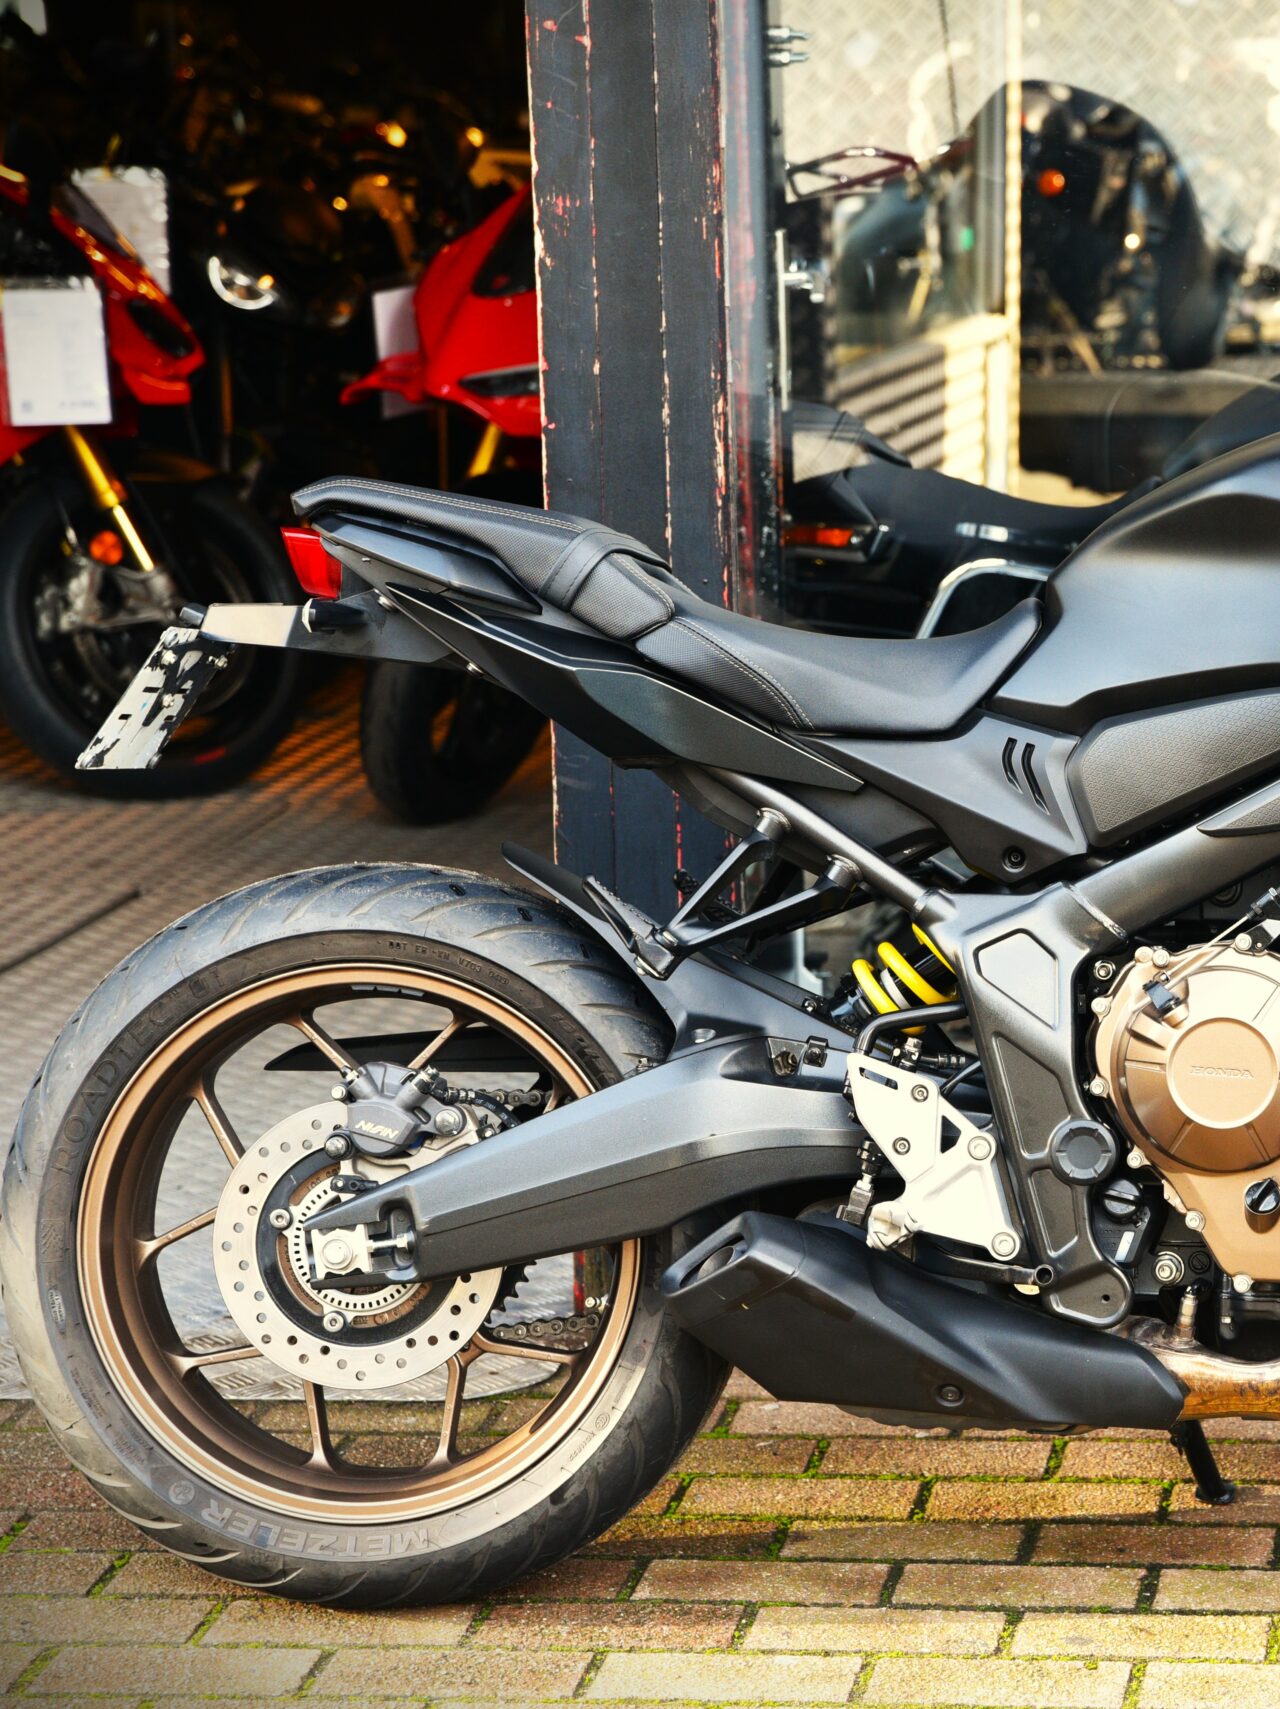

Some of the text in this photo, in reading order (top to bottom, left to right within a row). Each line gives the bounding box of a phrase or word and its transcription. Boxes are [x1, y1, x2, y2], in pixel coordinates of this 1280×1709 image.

[51, 1001, 177, 1176] ROADTEC
[1190, 1065, 1255, 1079] HONDA
[200, 1498, 431, 1557] METZELER
